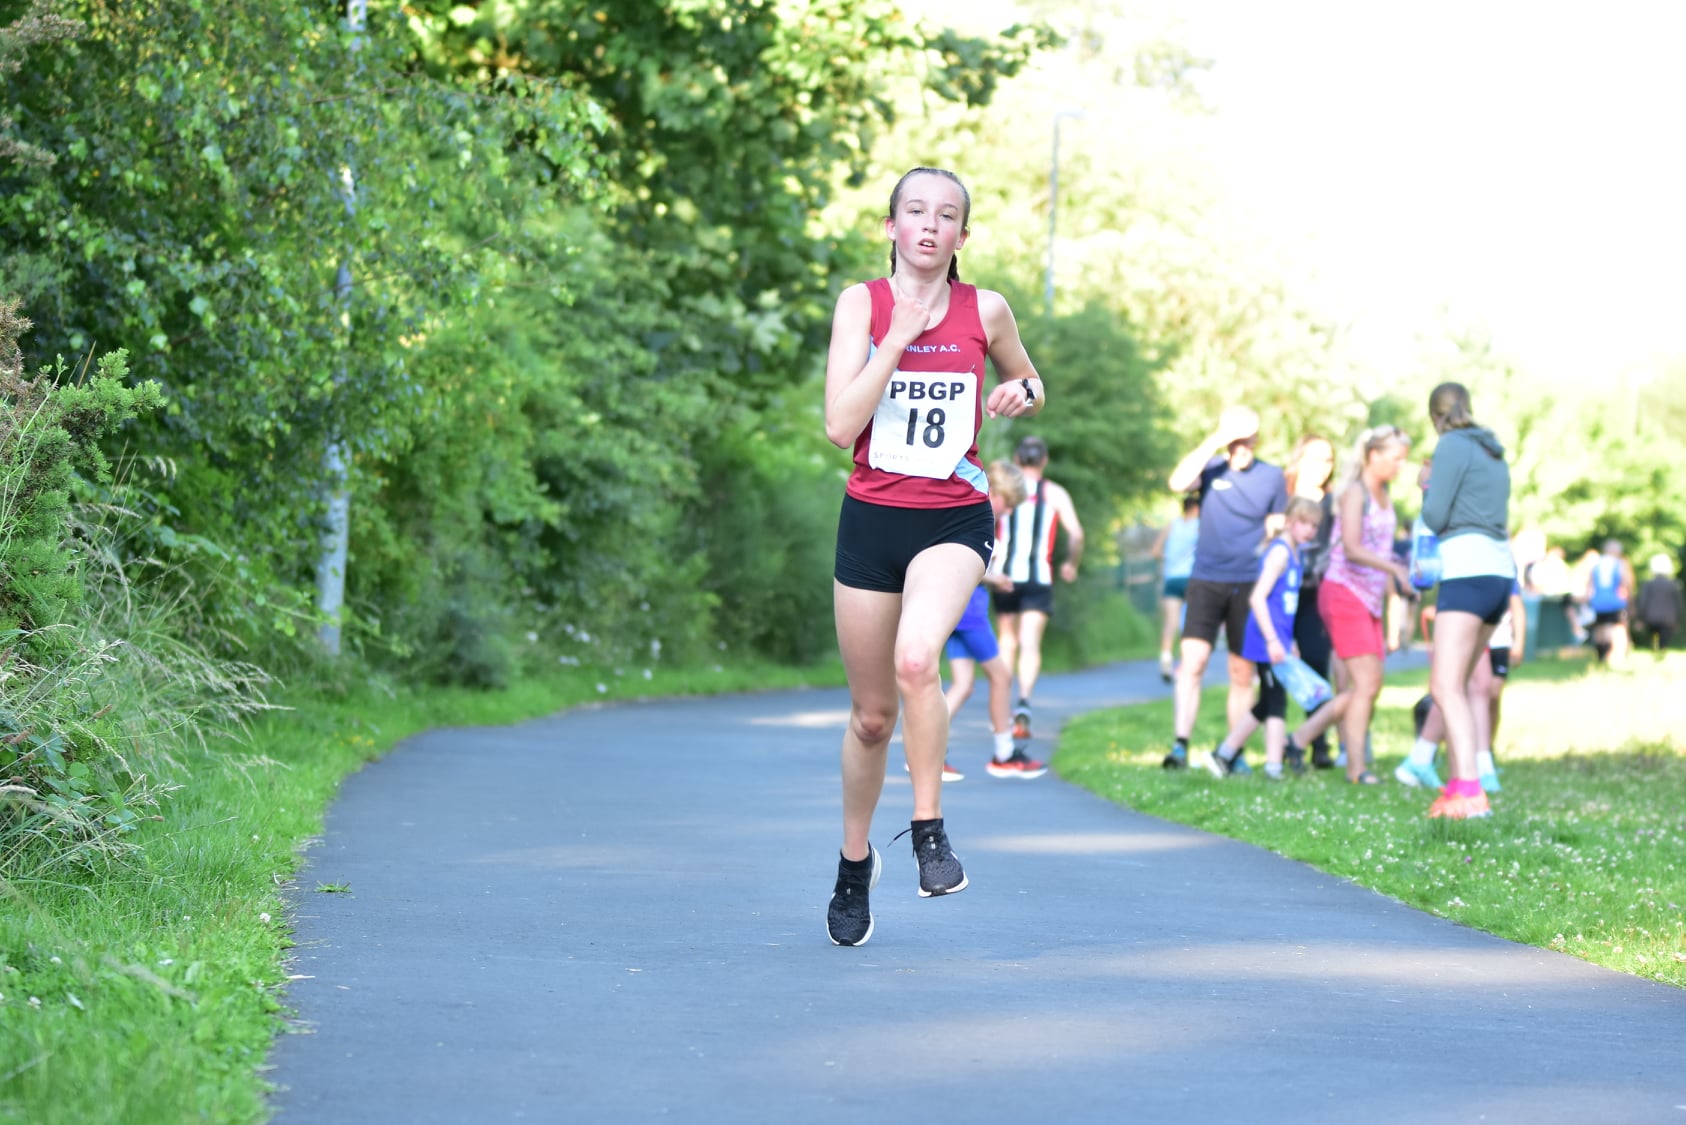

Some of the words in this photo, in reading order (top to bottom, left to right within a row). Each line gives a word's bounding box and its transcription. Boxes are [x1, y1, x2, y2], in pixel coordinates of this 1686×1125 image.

[939, 344, 961, 353] A.C.
[889, 381, 966, 401] PBGP
[906, 408, 946, 449] 18
